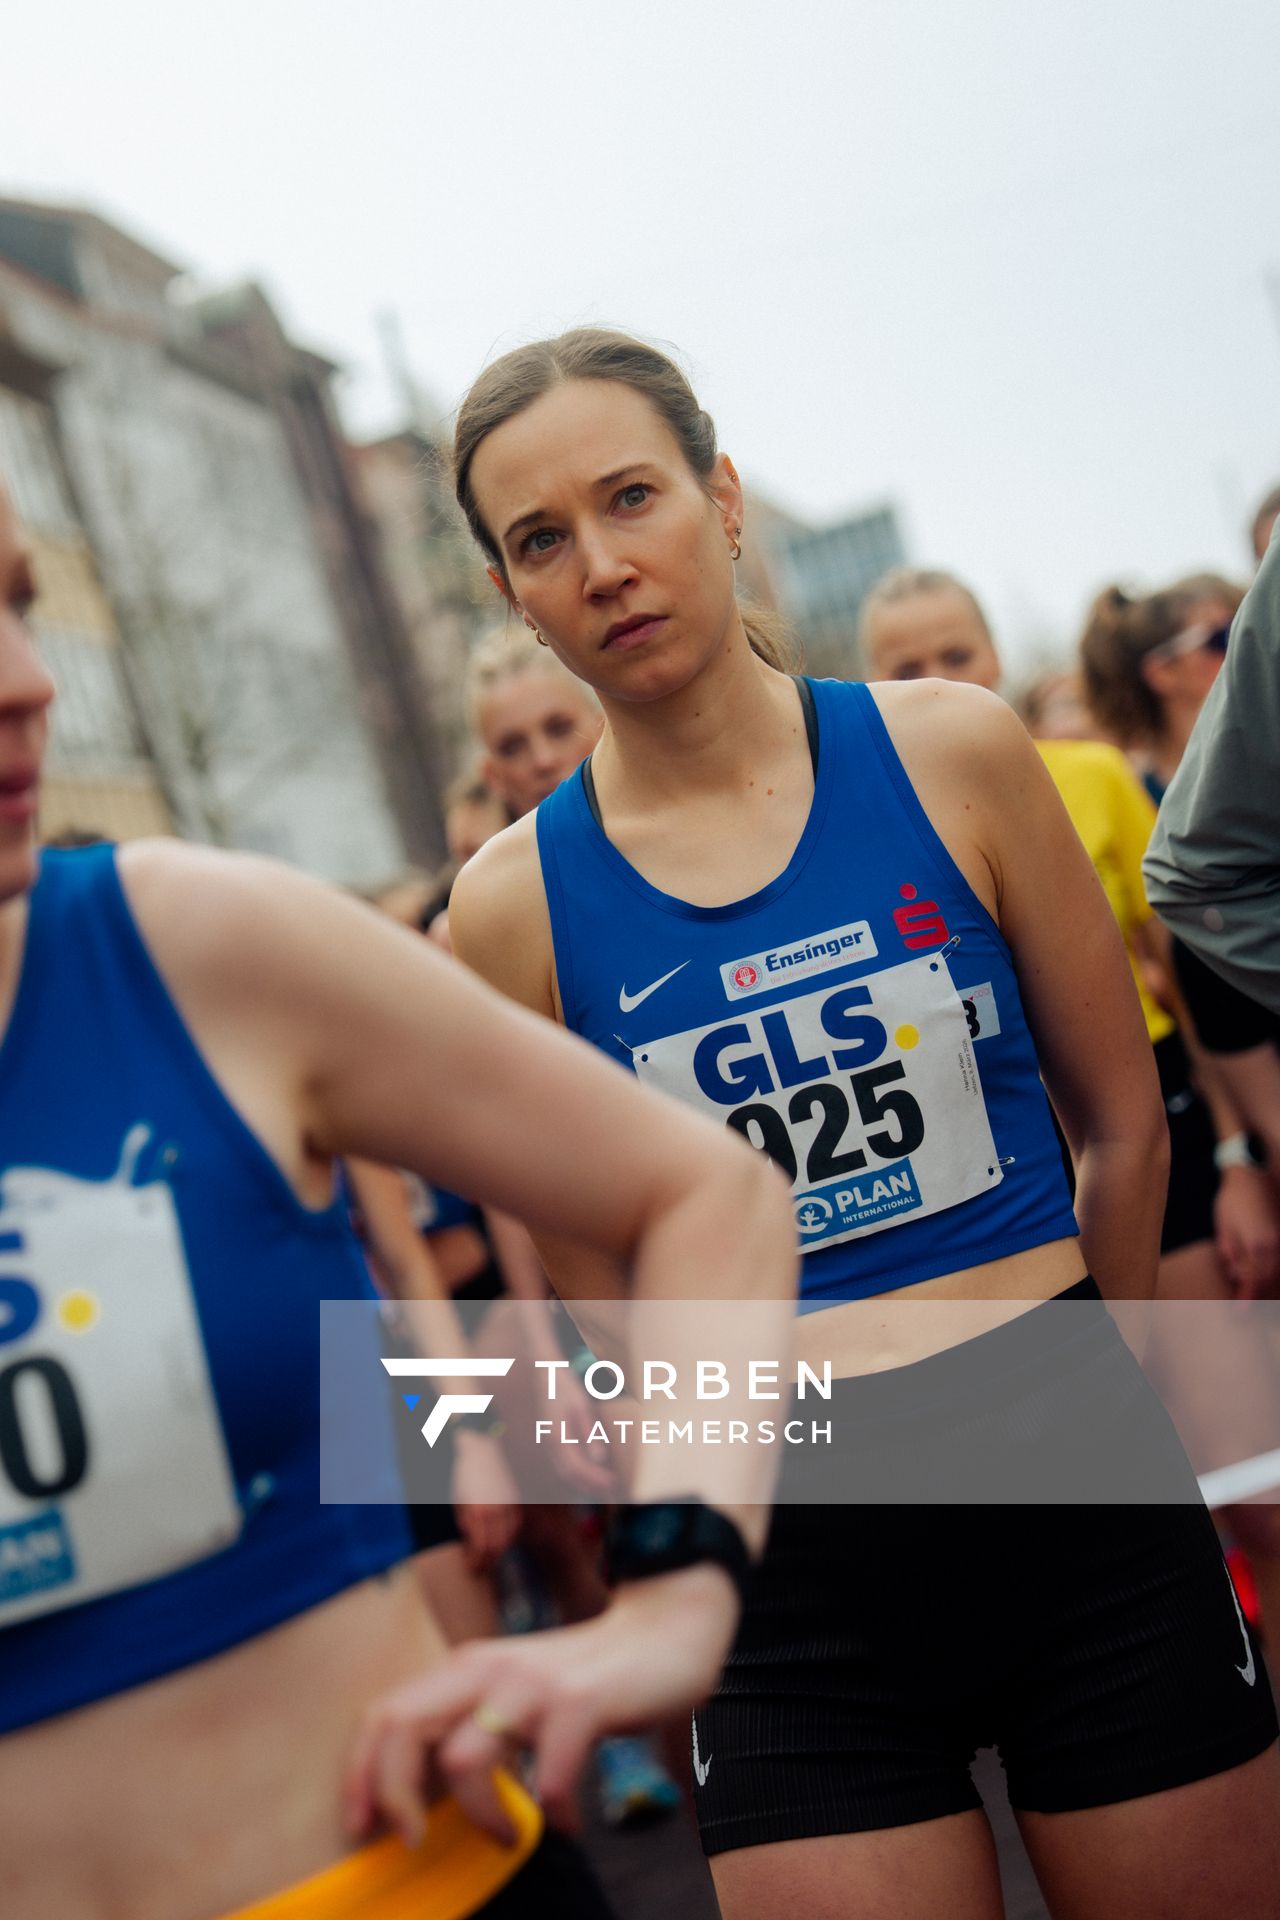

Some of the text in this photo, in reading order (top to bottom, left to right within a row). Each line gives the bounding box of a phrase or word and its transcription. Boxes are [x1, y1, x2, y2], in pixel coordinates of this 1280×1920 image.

[765, 931, 864, 972] Ensinger
[835, 1171, 912, 1213] PLAN
[842, 1195, 915, 1224] INTERNATIONAL
